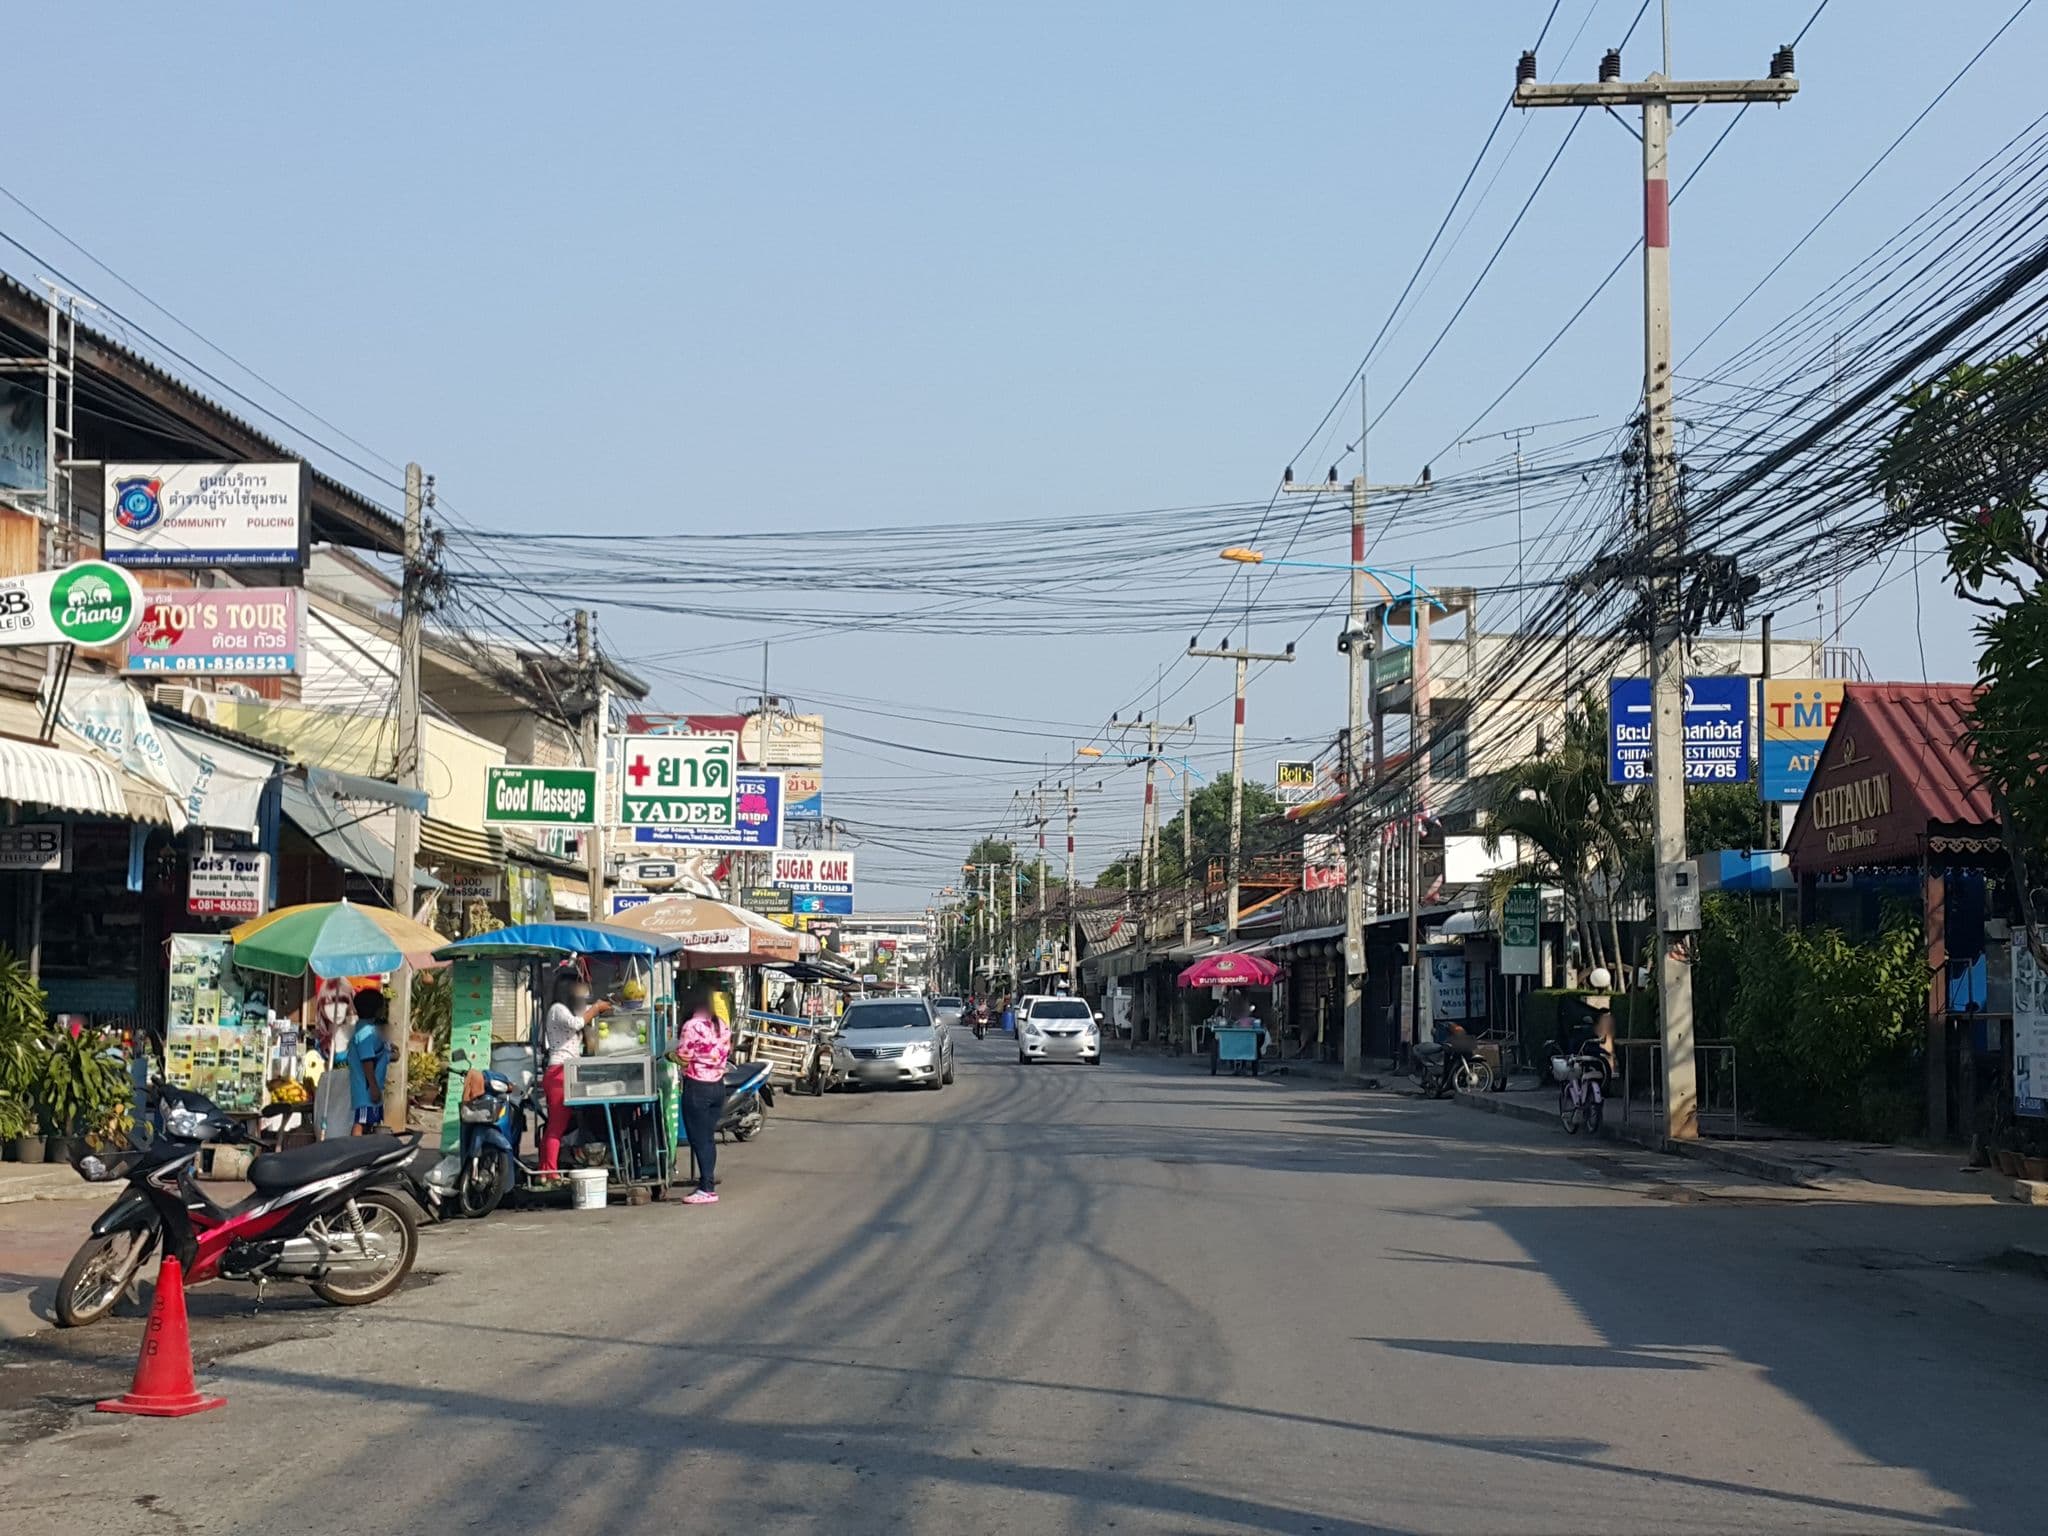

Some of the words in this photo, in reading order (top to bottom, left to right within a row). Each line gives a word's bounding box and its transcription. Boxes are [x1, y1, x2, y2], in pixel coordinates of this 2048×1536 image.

[199, 473, 267, 491] ศูนย์บริการ
[169, 488, 288, 511] ตำรวจผู้รับใช้ชุมชน
[163, 517, 227, 528] COMMUNITY
[247, 517, 294, 528] POLICING
[61, 604, 123, 626] Chang
[223, 604, 288, 631] TOUR
[212, 632, 248, 648] ต้อย
[254, 630, 287, 648] ทัวร์
[143, 658, 169, 670] Tel.
[176, 657, 287, 670] 081-8565523
[1707, 746, 1742, 758] HOUSE
[657, 746, 729, 788] ยาดี
[496, 778, 529, 811] Good
[532, 779, 586, 819] Massage
[1812, 773, 1891, 831] CHITANUN
[627, 801, 727, 823] YADEE
[192, 857, 224, 871] Toi's
[229, 858, 260, 872] Tour
[776, 859, 813, 880] SUGAR
[820, 860, 848, 882] CANE
[812, 883, 849, 893] House
